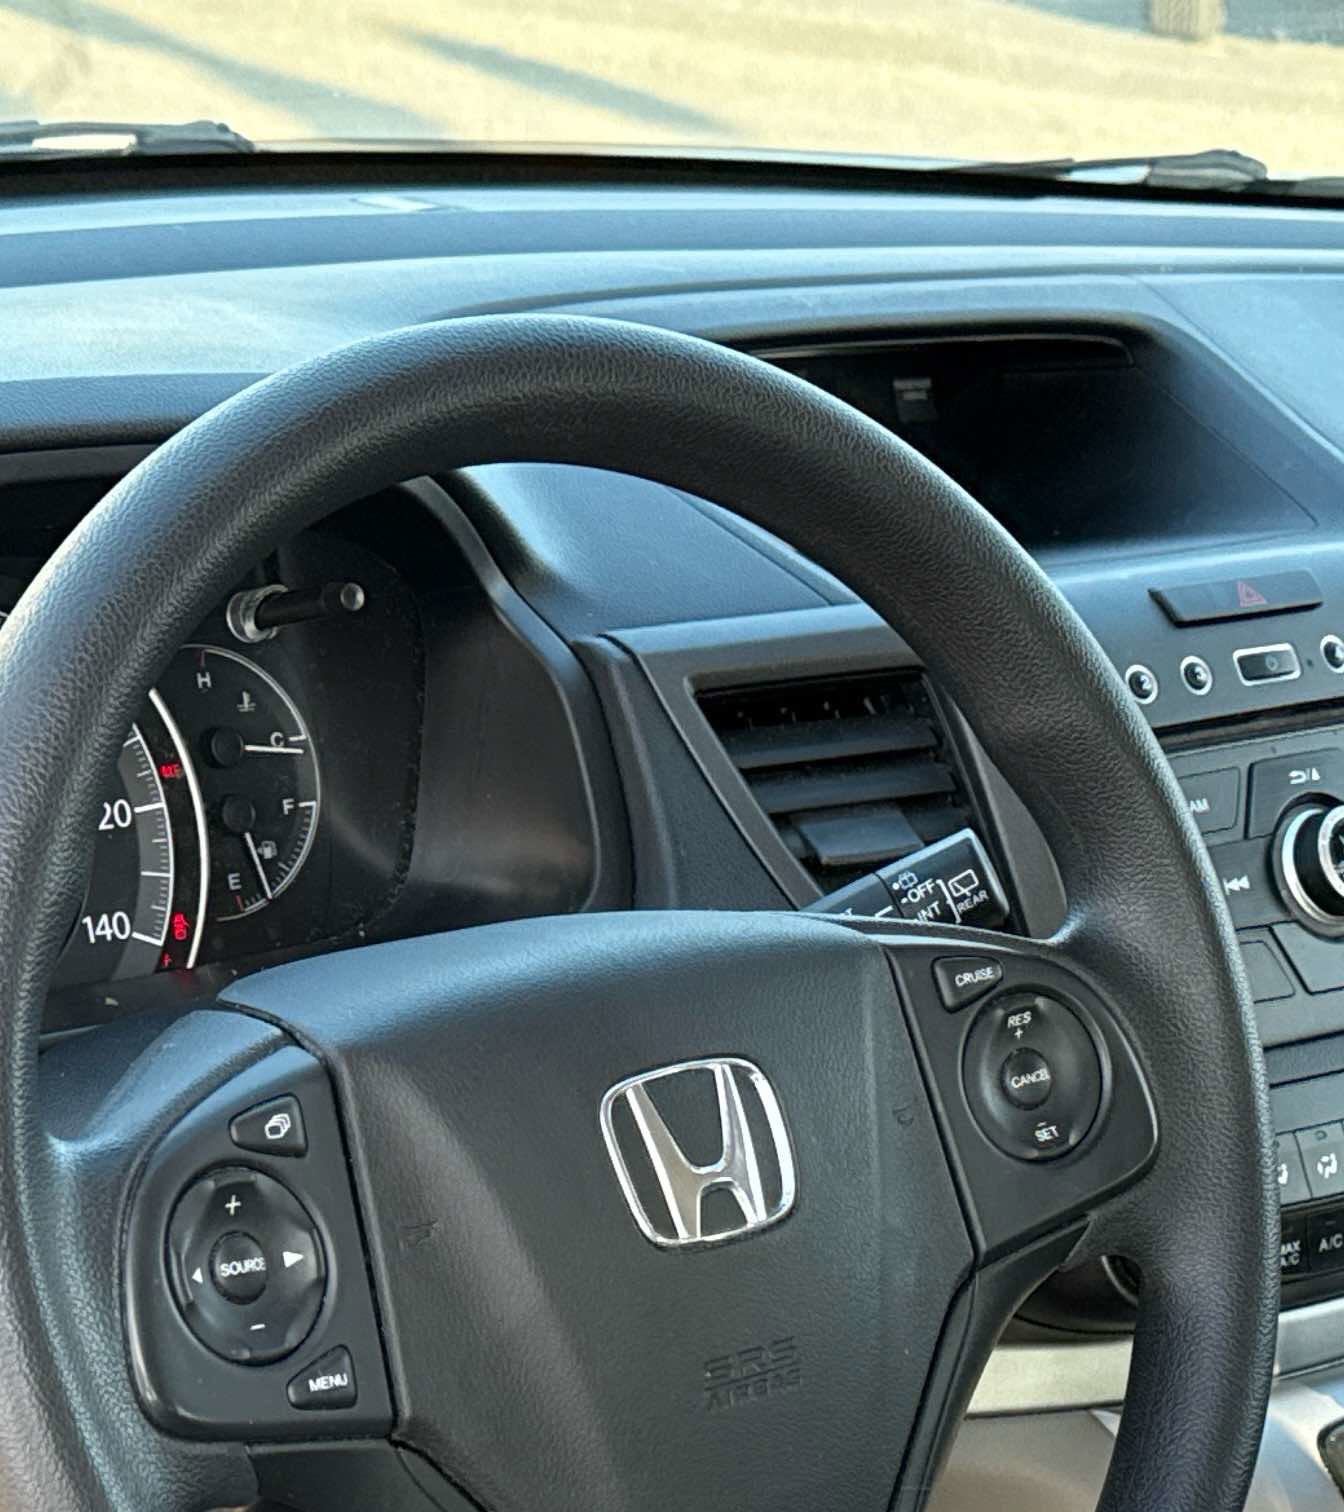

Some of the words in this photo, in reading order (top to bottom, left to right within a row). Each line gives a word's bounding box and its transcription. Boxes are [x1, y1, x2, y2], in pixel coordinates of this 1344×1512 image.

[197, 672, 212, 689] H
[270, 731, 285, 747] C
[282, 798, 295, 816] F
[227, 872, 242, 890] E
[907, 878, 937, 903] OFF
[956, 889, 989, 914] REAR
[82, 911, 133, 944] 140
[955, 966, 995, 987] CRUISE
[1007, 1011, 1033, 1029] RES
[1010, 1068, 1051, 1088] CANCEL
[1035, 1124, 1058, 1142] SET
[1319, 1233, 1344, 1253] A/C
[219, 1255, 267, 1278] SOURCE
[308, 1373, 349, 1393] MENU
